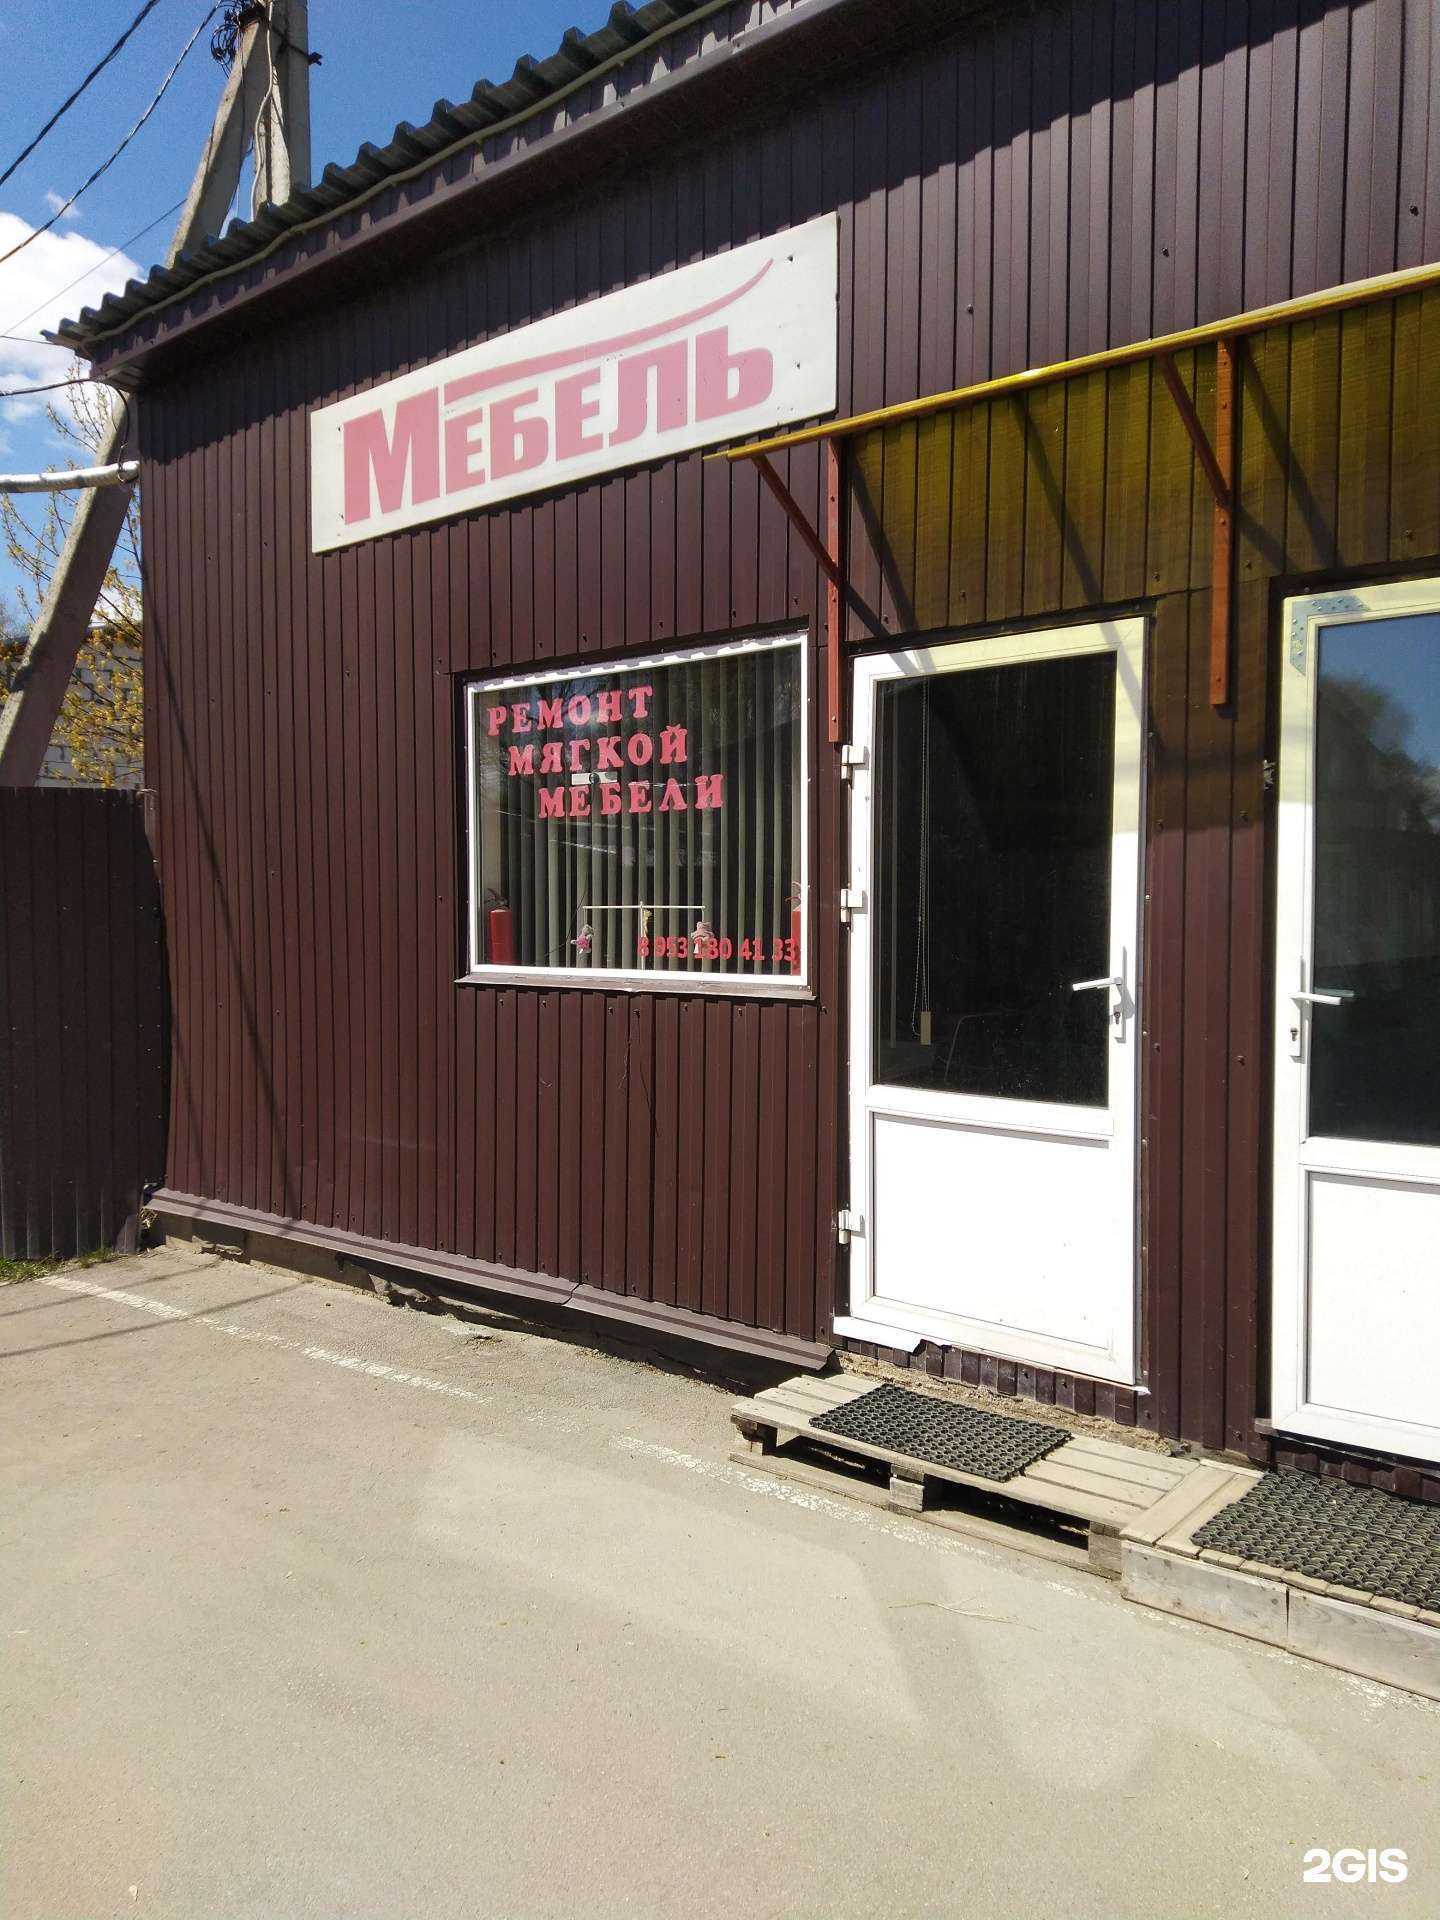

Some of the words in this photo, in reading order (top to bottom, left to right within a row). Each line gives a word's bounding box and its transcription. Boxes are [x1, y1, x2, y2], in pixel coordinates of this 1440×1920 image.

[343, 326, 774, 525] МЕБЕЛЬ
[487, 686, 653, 736] РЕМОНТ
[508, 724, 688, 776] МЯГКОЙ
[538, 774, 724, 818] МЕБЕЛИ
[637, 936, 649, 958] 8
[655, 936, 688, 959] 953
[693, 937, 732, 960] 180
[740, 937, 764, 961] 41
